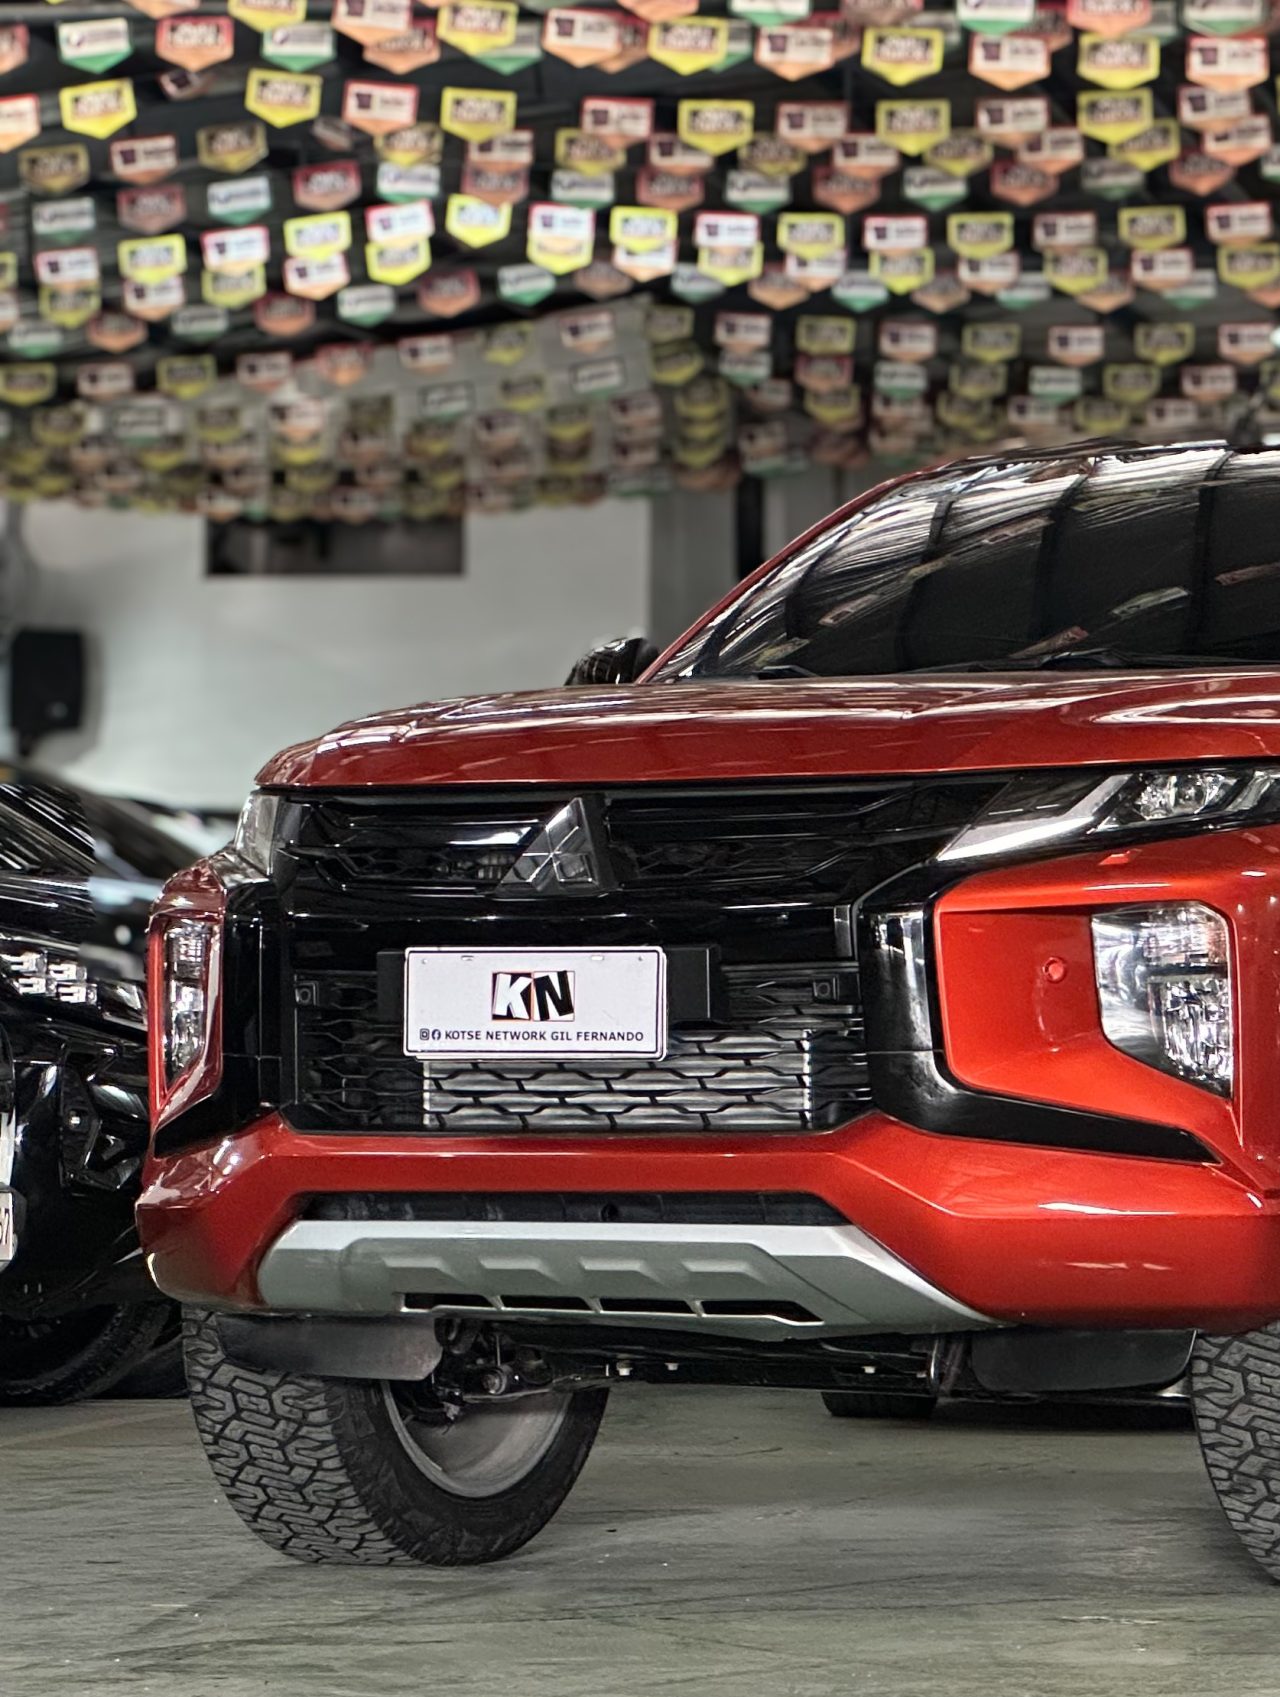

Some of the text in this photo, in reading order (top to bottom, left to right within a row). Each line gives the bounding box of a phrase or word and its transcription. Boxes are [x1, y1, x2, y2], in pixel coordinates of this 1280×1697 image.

[493, 970, 575, 1022] KN
[445, 1030, 645, 1042] KOTSE NETWORK GIL FERNANDO
